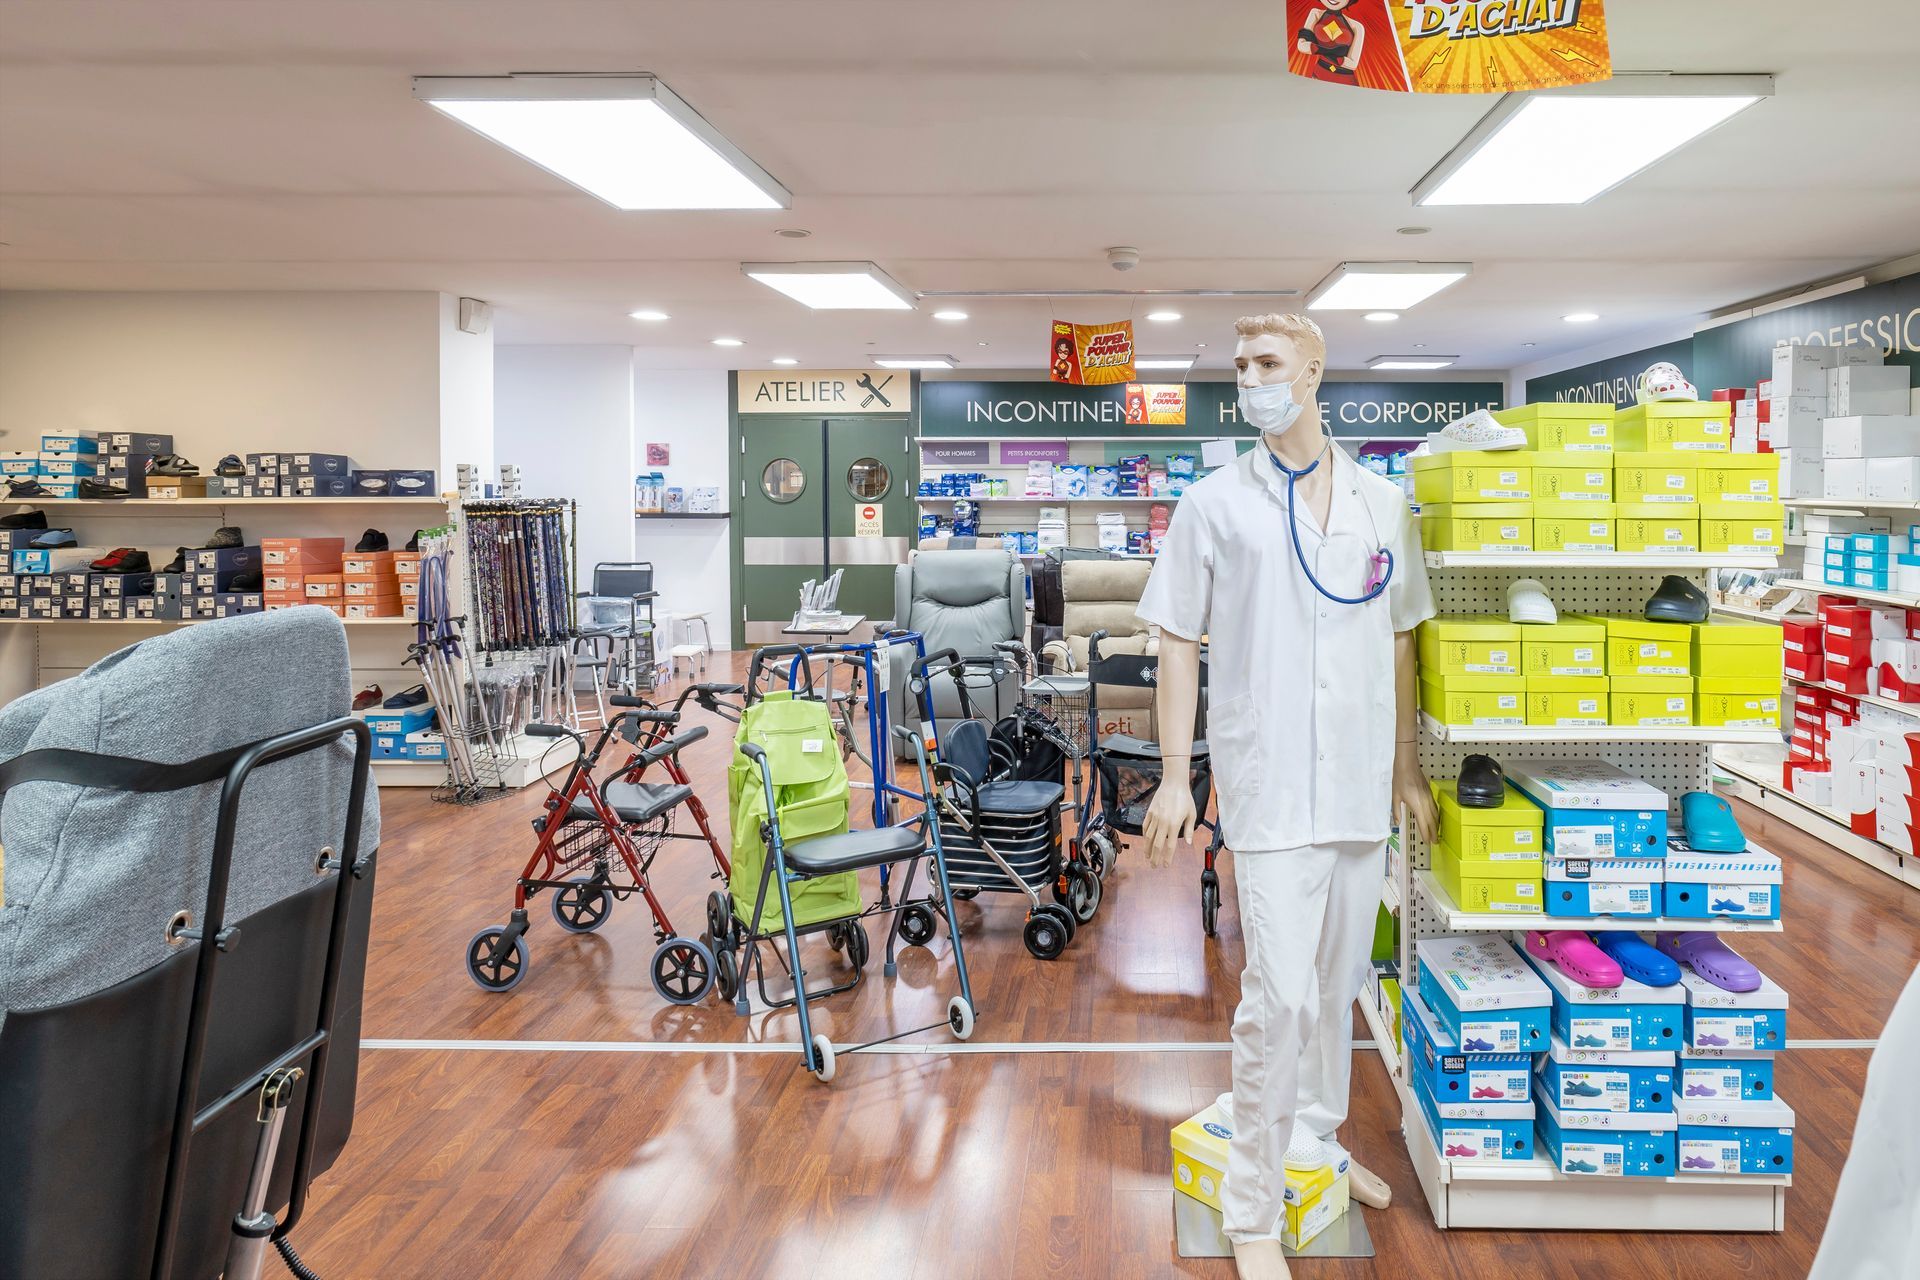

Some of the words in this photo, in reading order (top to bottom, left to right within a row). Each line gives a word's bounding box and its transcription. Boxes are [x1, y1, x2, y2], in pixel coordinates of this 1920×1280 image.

[1415, 0, 1573, 35] D'ACHAT
[1502, 78, 1533, 88] produits
[1092, 333, 1125, 346] SUPER
[1087, 342, 1130, 356] POUVOIR
[1087, 351, 1129, 366] D'ACHAT
[755, 381, 846, 402] ATELIER
